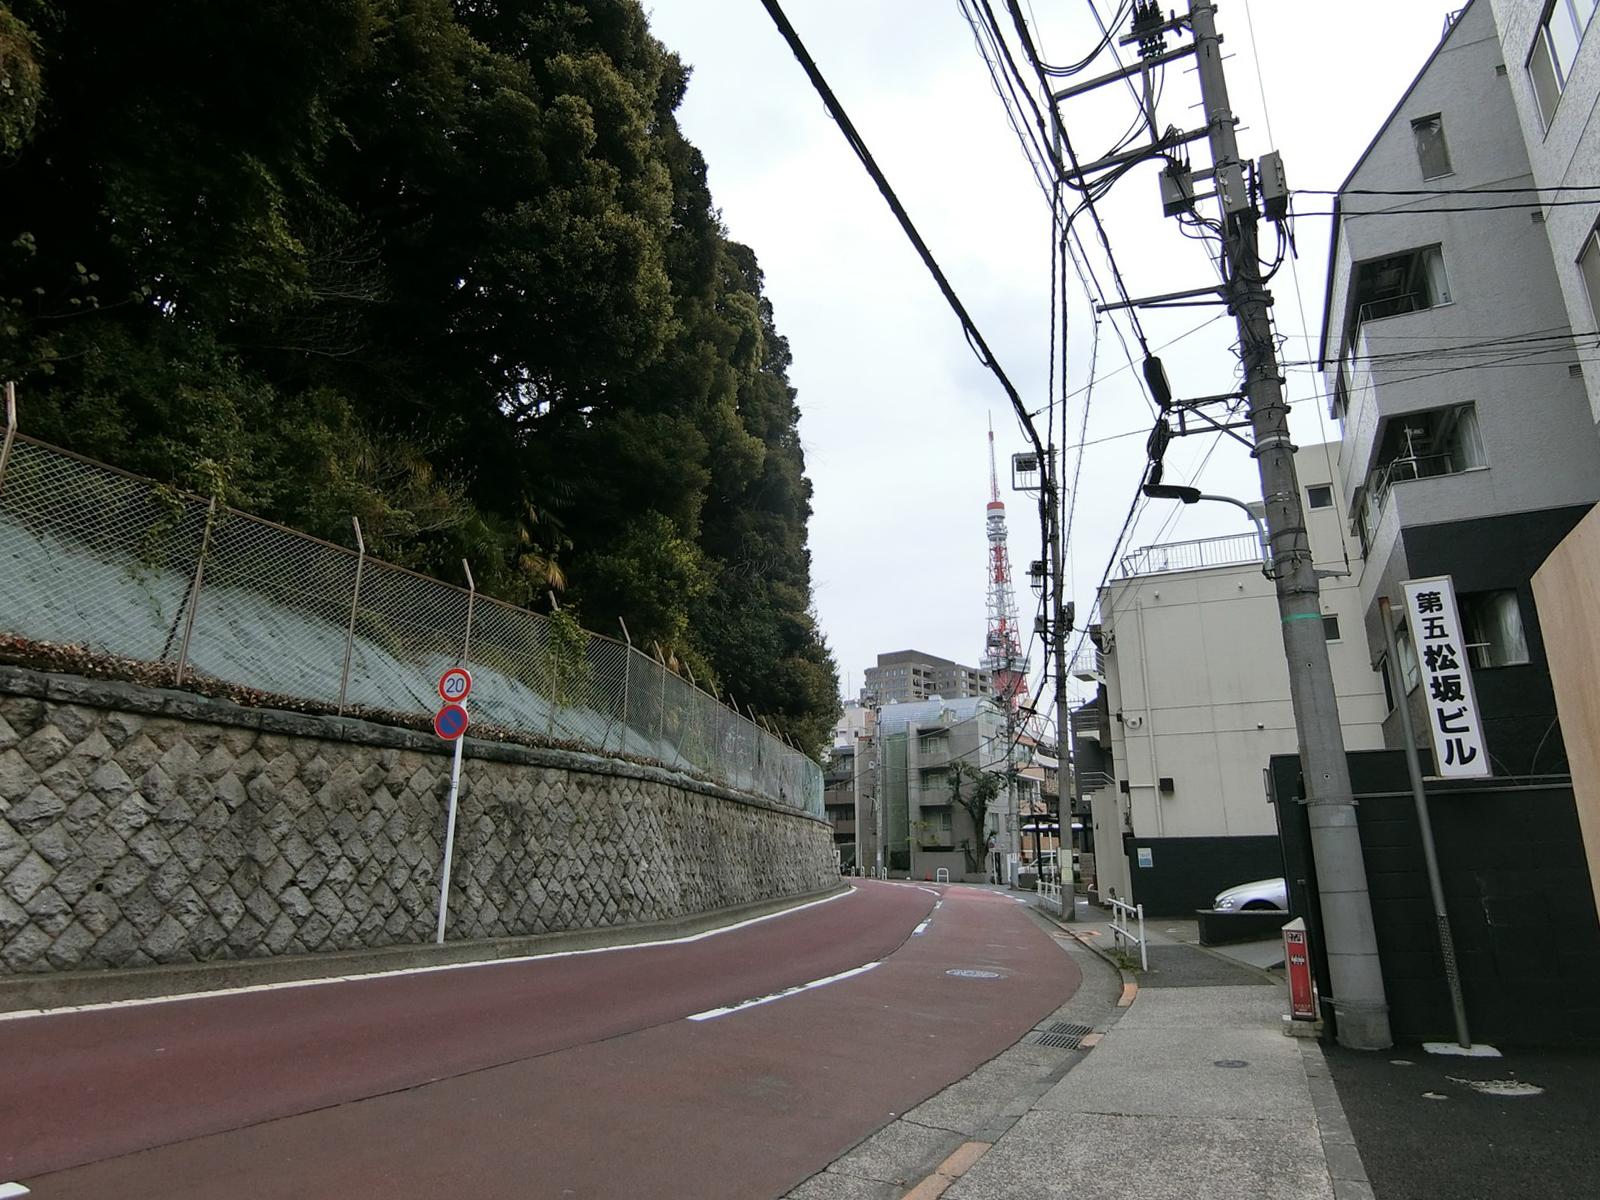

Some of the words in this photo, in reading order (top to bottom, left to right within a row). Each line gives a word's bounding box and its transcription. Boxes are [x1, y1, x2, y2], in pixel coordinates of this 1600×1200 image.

[446, 678, 464, 693] 20
[1416, 591, 1477, 766] 第五松坂ビル
